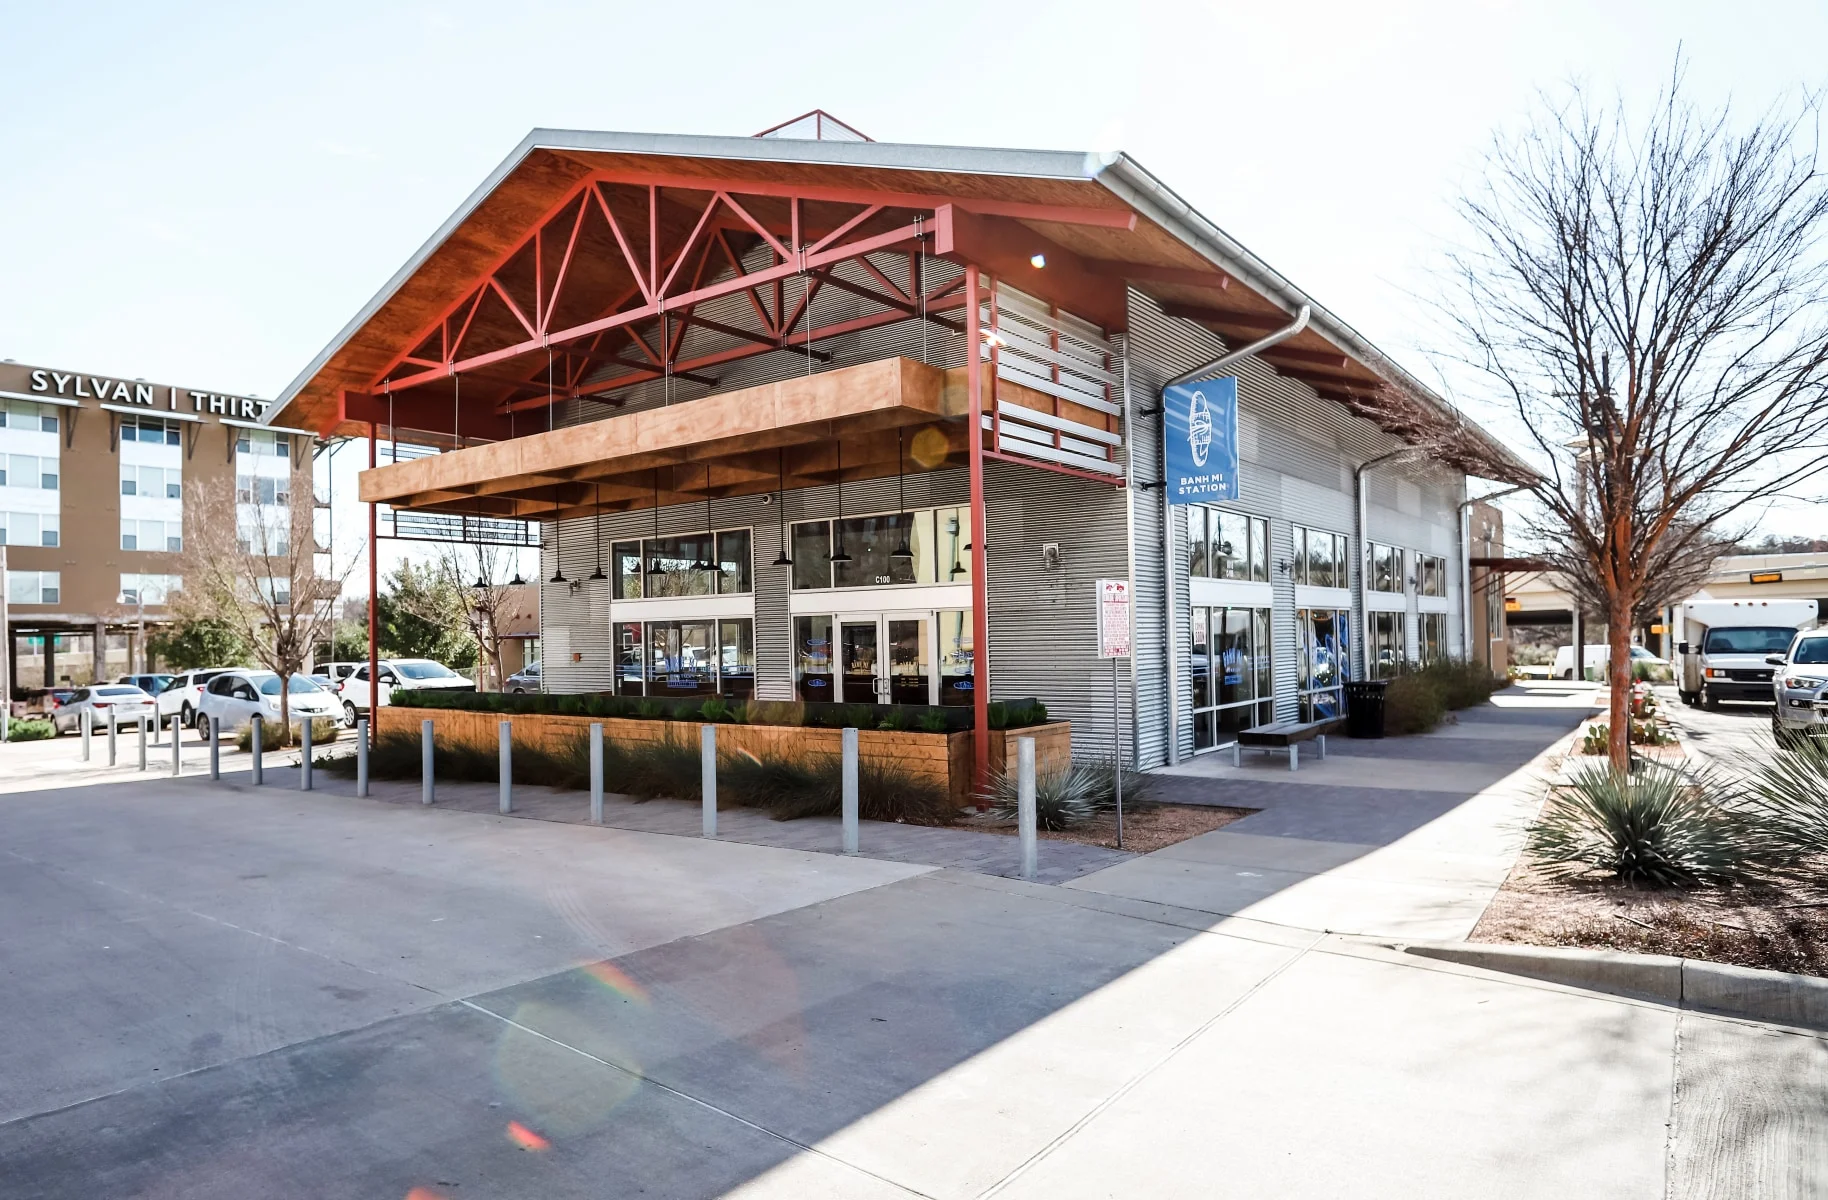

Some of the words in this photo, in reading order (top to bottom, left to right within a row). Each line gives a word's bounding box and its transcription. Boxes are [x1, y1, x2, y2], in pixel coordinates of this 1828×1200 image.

[31, 369, 153, 405] SYLVAN
[1180, 475, 1210, 486] BANH
[1211, 473, 1223, 483] MI
[1178, 483, 1227, 495] STATION
[875, 575, 891, 584] C100
